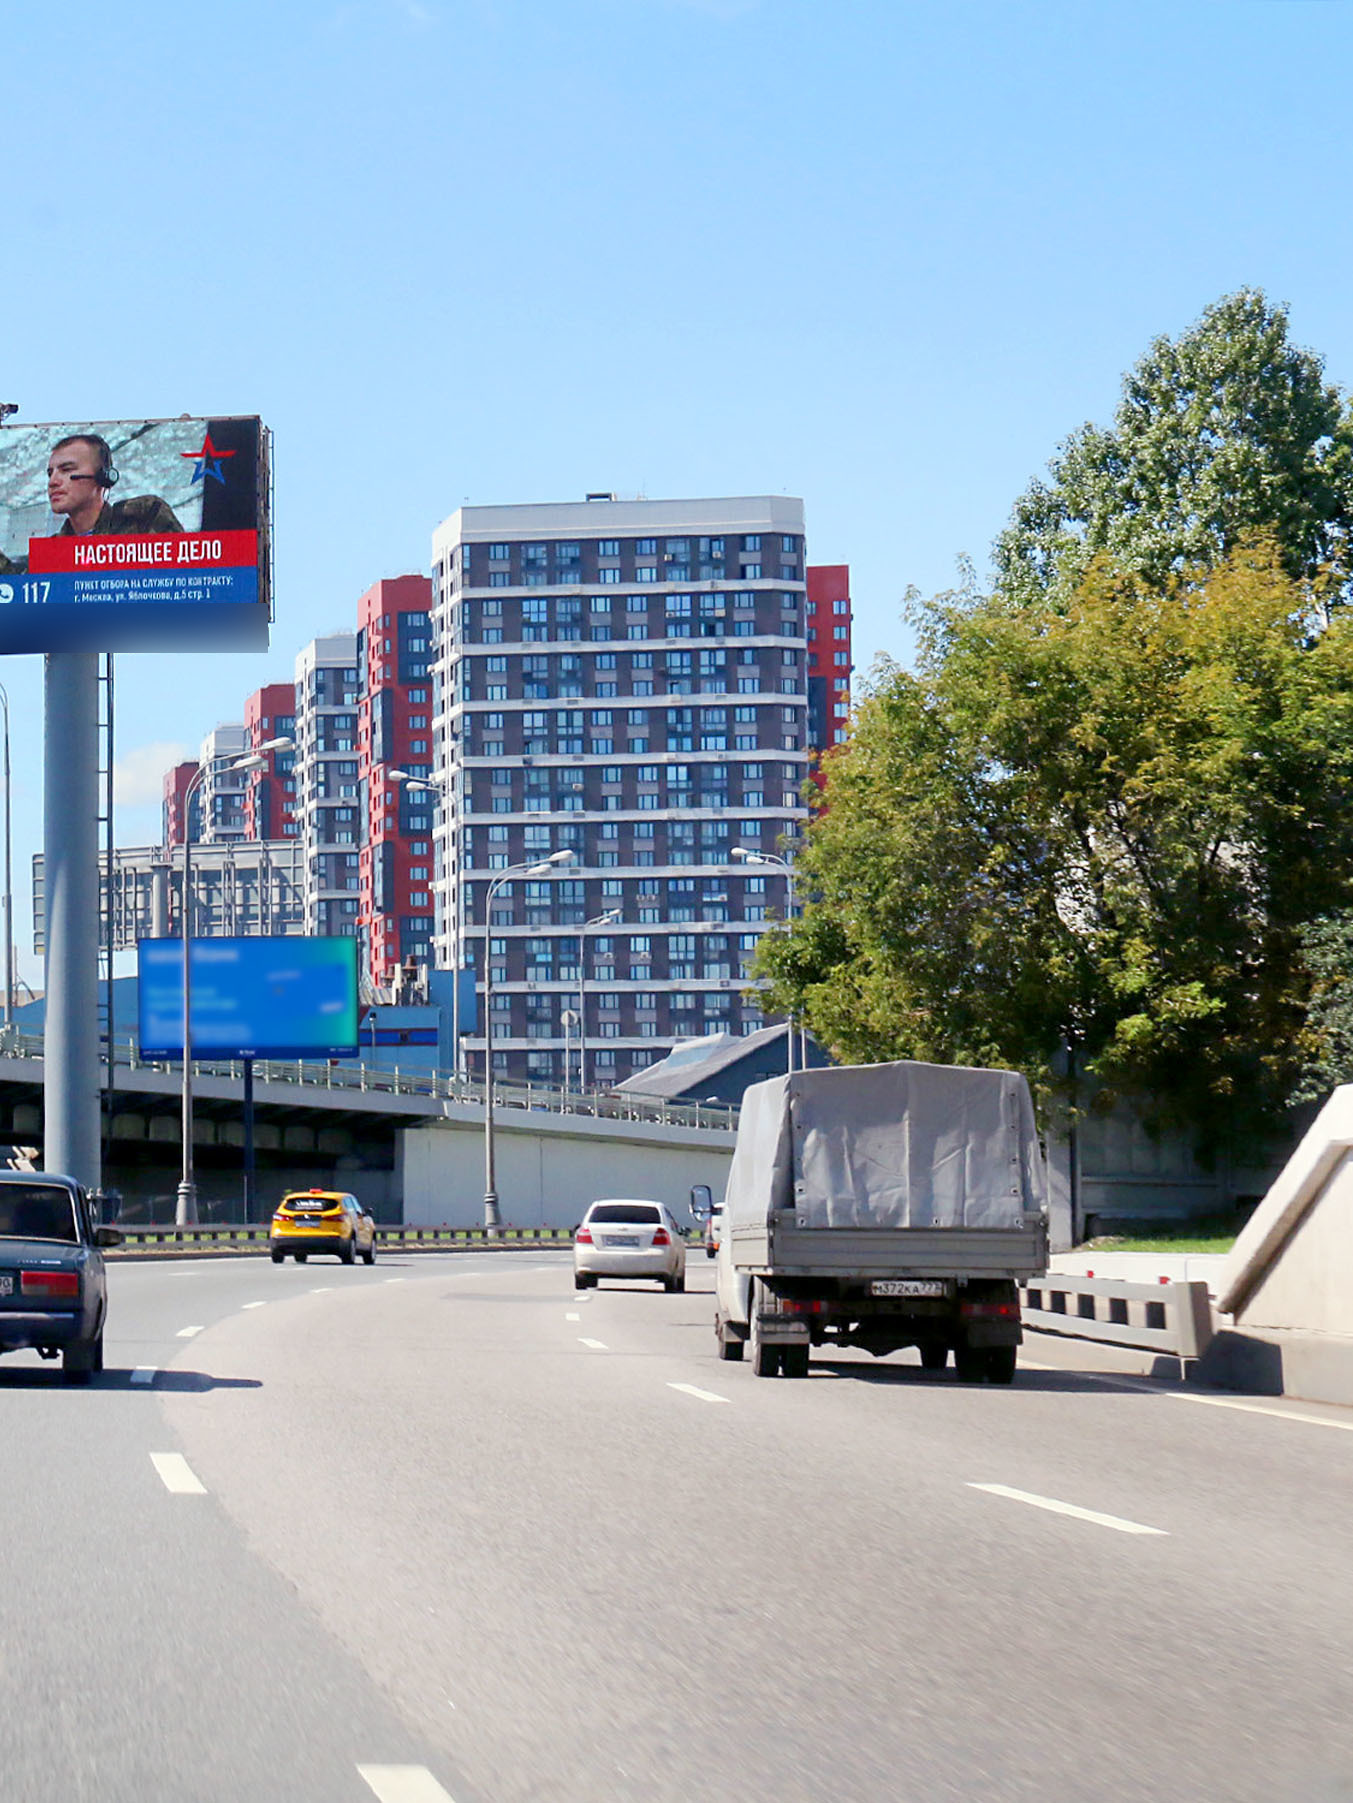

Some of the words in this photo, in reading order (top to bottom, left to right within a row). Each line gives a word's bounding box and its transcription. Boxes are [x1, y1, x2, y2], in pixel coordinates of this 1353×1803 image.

[74, 541, 173, 565] НАСТОЯЩЕЕ
[177, 539, 222, 564] ДЕЛО
[22, 581, 50, 603] 117
[74, 579, 99, 591] ПУНКТ
[100, 578, 130, 590] ОТБОРА
[131, 577, 141, 589] НА
[142, 576, 174, 589] СЛУЖБУ
[175, 576, 187, 587] ПО
